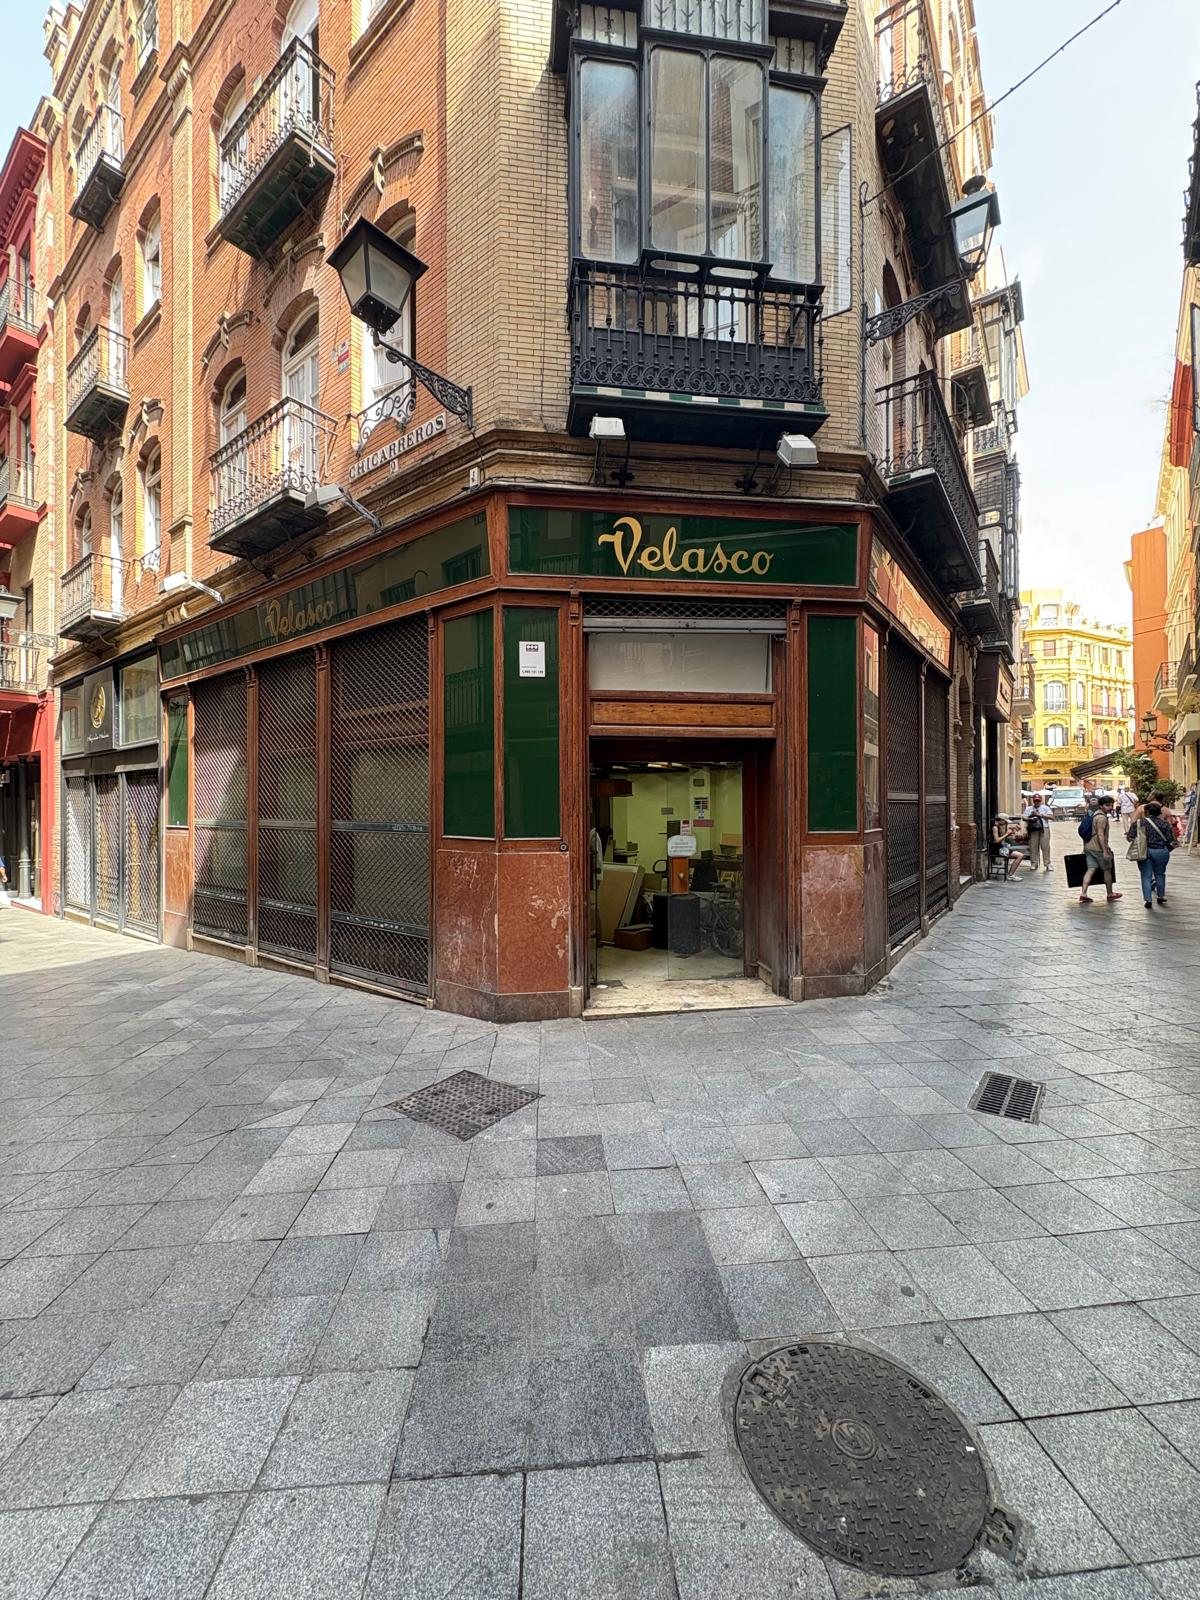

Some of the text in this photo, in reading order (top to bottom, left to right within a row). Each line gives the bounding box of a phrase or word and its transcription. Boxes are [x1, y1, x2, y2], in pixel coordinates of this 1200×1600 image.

[348, 414, 445, 480] CHICARREROS
[598, 516, 775, 576] Velasco
[265, 599, 334, 636] Velasco
